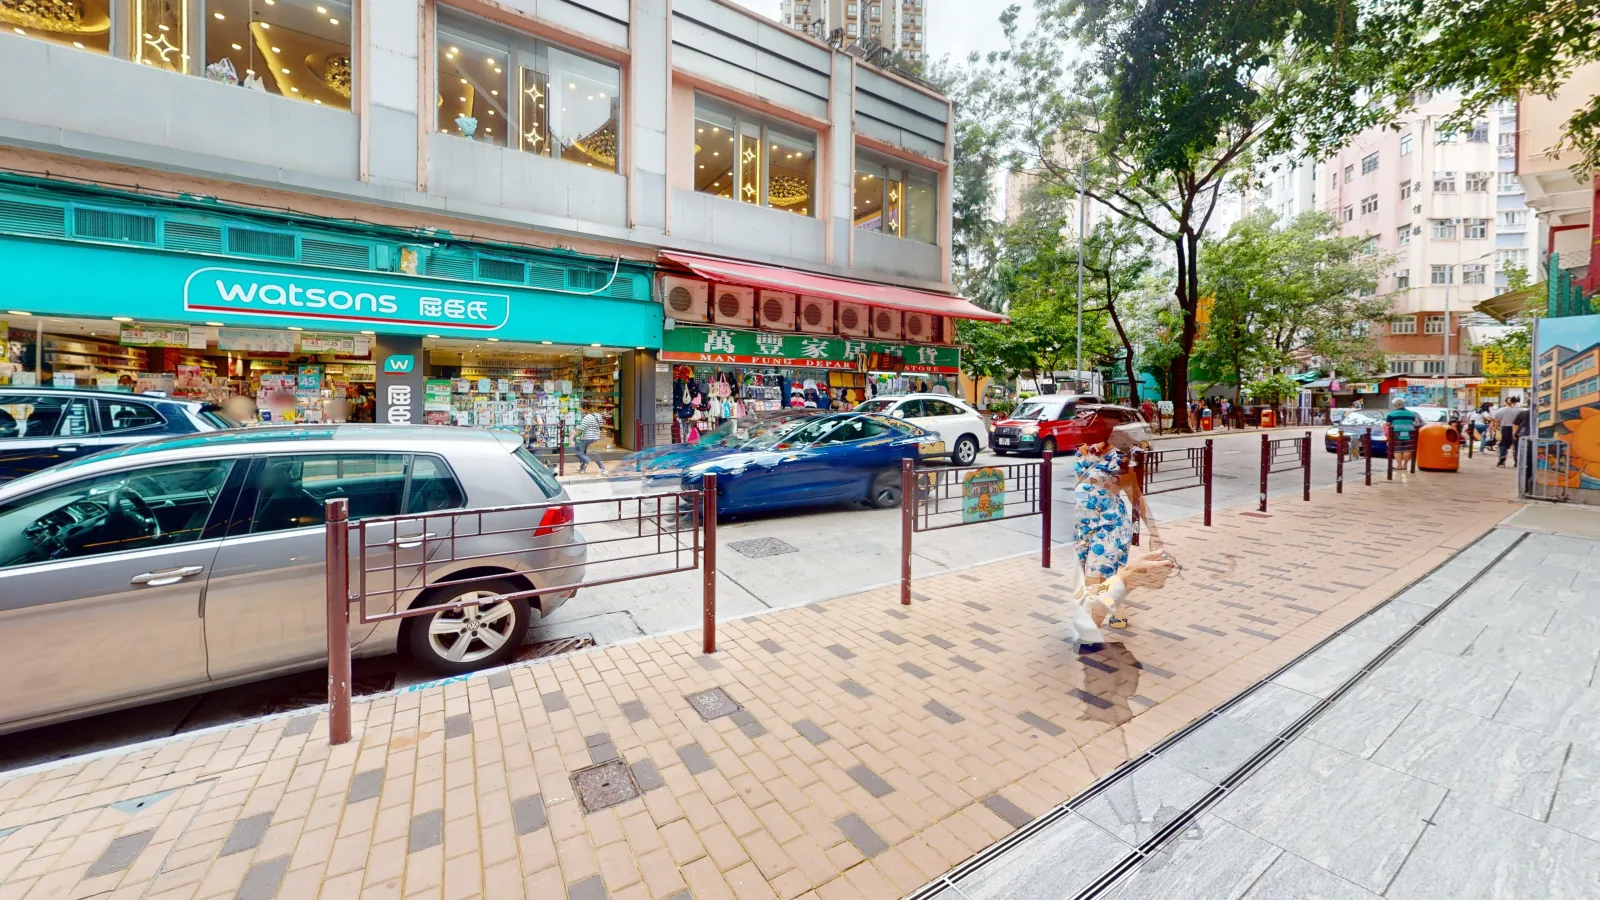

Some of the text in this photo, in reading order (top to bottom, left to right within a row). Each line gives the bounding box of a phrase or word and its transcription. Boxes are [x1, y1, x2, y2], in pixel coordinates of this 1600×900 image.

[216, 279, 488, 320] watsons 屈臣氏
[700, 354, 736, 362] MAN
[751, 357, 797, 365] FUNG
[301, 377, 316, 387] 45
